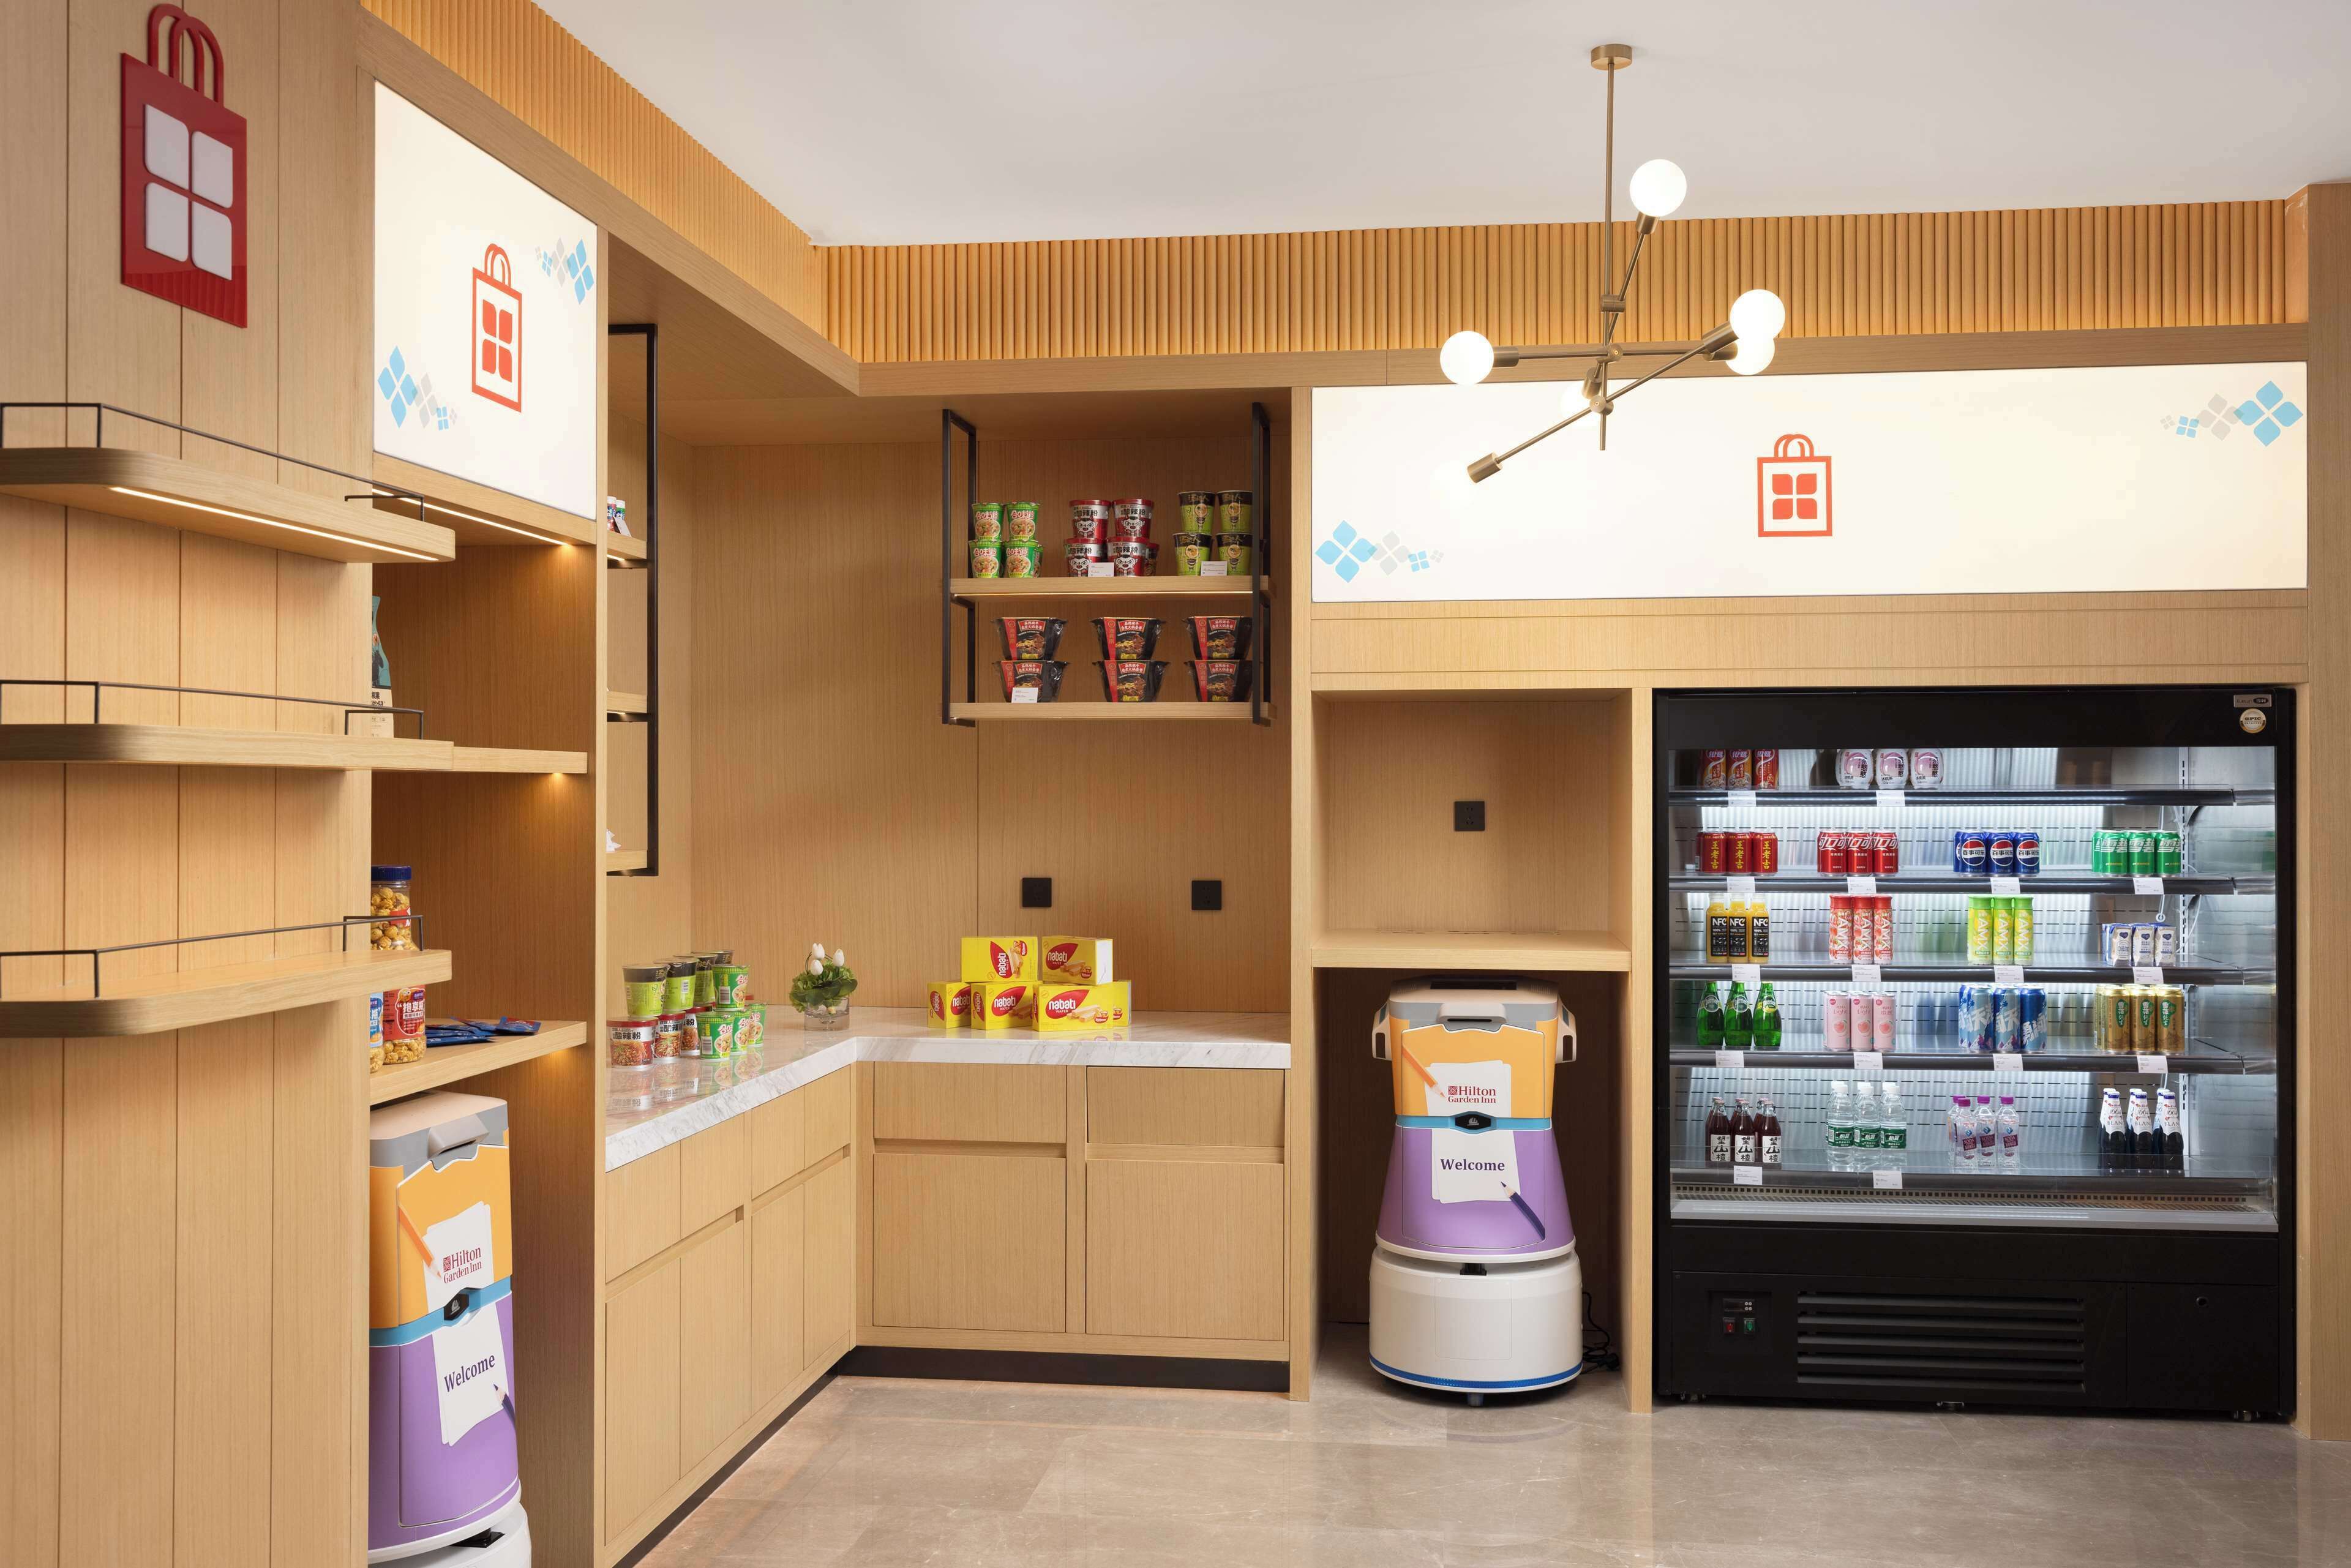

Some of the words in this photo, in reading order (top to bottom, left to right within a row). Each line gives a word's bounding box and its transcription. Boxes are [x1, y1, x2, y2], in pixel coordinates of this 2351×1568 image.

[1711, 841, 1719, 869] 王老吉
[1735, 841, 1744, 869] 王老吉
[1763, 841, 1771, 869] 王老吉
[1837, 917, 1848, 948] AMX
[1861, 918, 1872, 950] AMX
[1881, 918, 1891, 949] AMX
[1978, 918, 1989, 950] AMX
[1998, 918, 2009, 950] AMX
[2018, 918, 2030, 950] AMX
[1048, 951, 1067, 962] nabati
[953, 991, 970, 1006] nabati
[994, 996, 1016, 1009] nabati
[1049, 999, 1076, 1010] nabati
[1459, 1086, 1496, 1096] Hilton
[1714, 1136, 1728, 1161] 望山楂
[1738, 1136, 1753, 1161] 望山楂
[1766, 1137, 1780, 1162] 望山楂
[1441, 1159, 1505, 1171] Welcome
[451, 1247, 481, 1270] Hilton
[444, 1267, 469, 1284] Garden
[470, 1261, 482, 1276] Inn
[444, 1354, 495, 1393] Welcome
